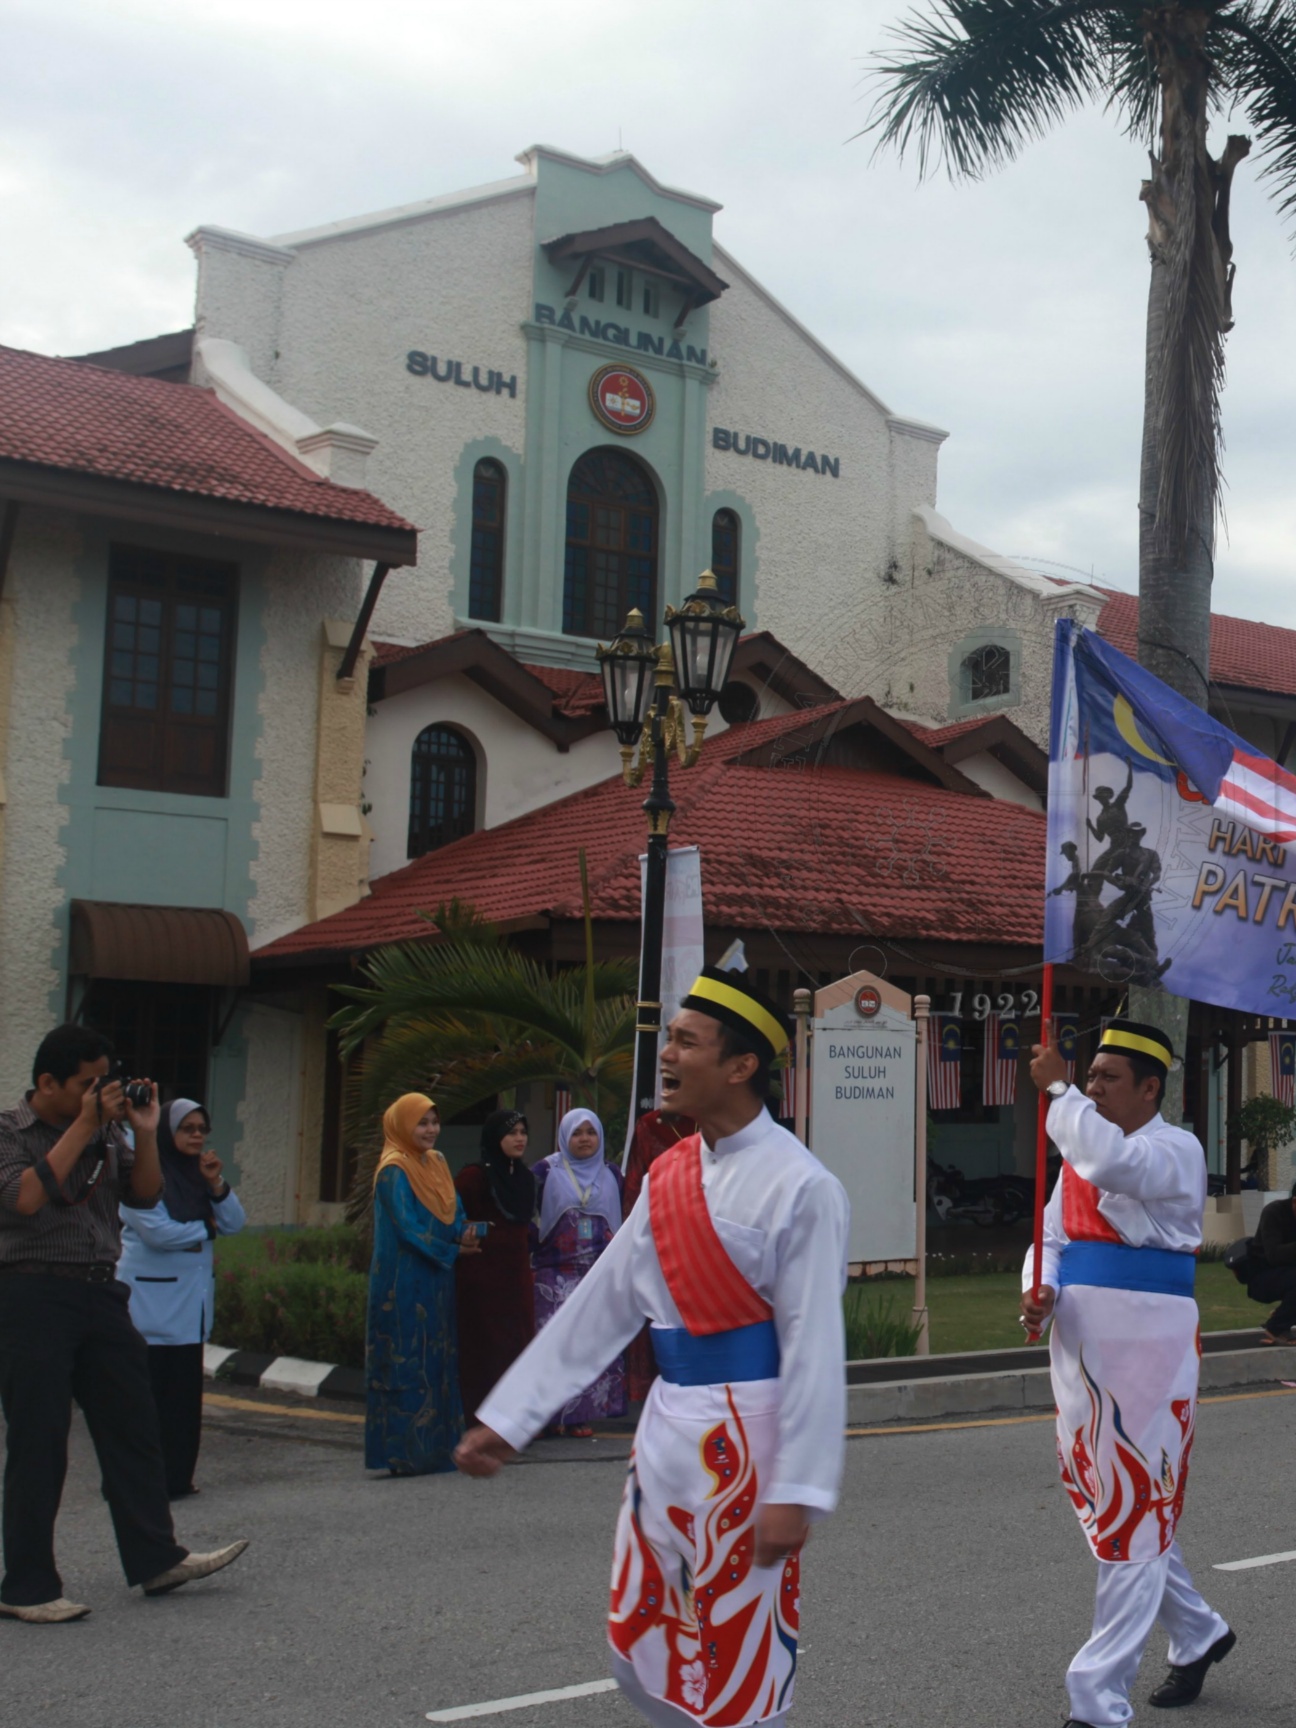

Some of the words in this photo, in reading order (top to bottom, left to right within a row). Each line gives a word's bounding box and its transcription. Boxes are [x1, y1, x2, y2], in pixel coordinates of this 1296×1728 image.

[535, 303, 706, 365] BANGUNAN
[406, 350, 517, 398] SULUH
[713, 427, 839, 478] BUDIMAN
[1208, 818, 1287, 867] HARI
[948, 989, 1041, 1020] 1922
[829, 1044, 902, 1059] BANGUNAN
[844, 1065, 886, 1079] SULUH
[835, 1086, 895, 1100] BUDIMAN
